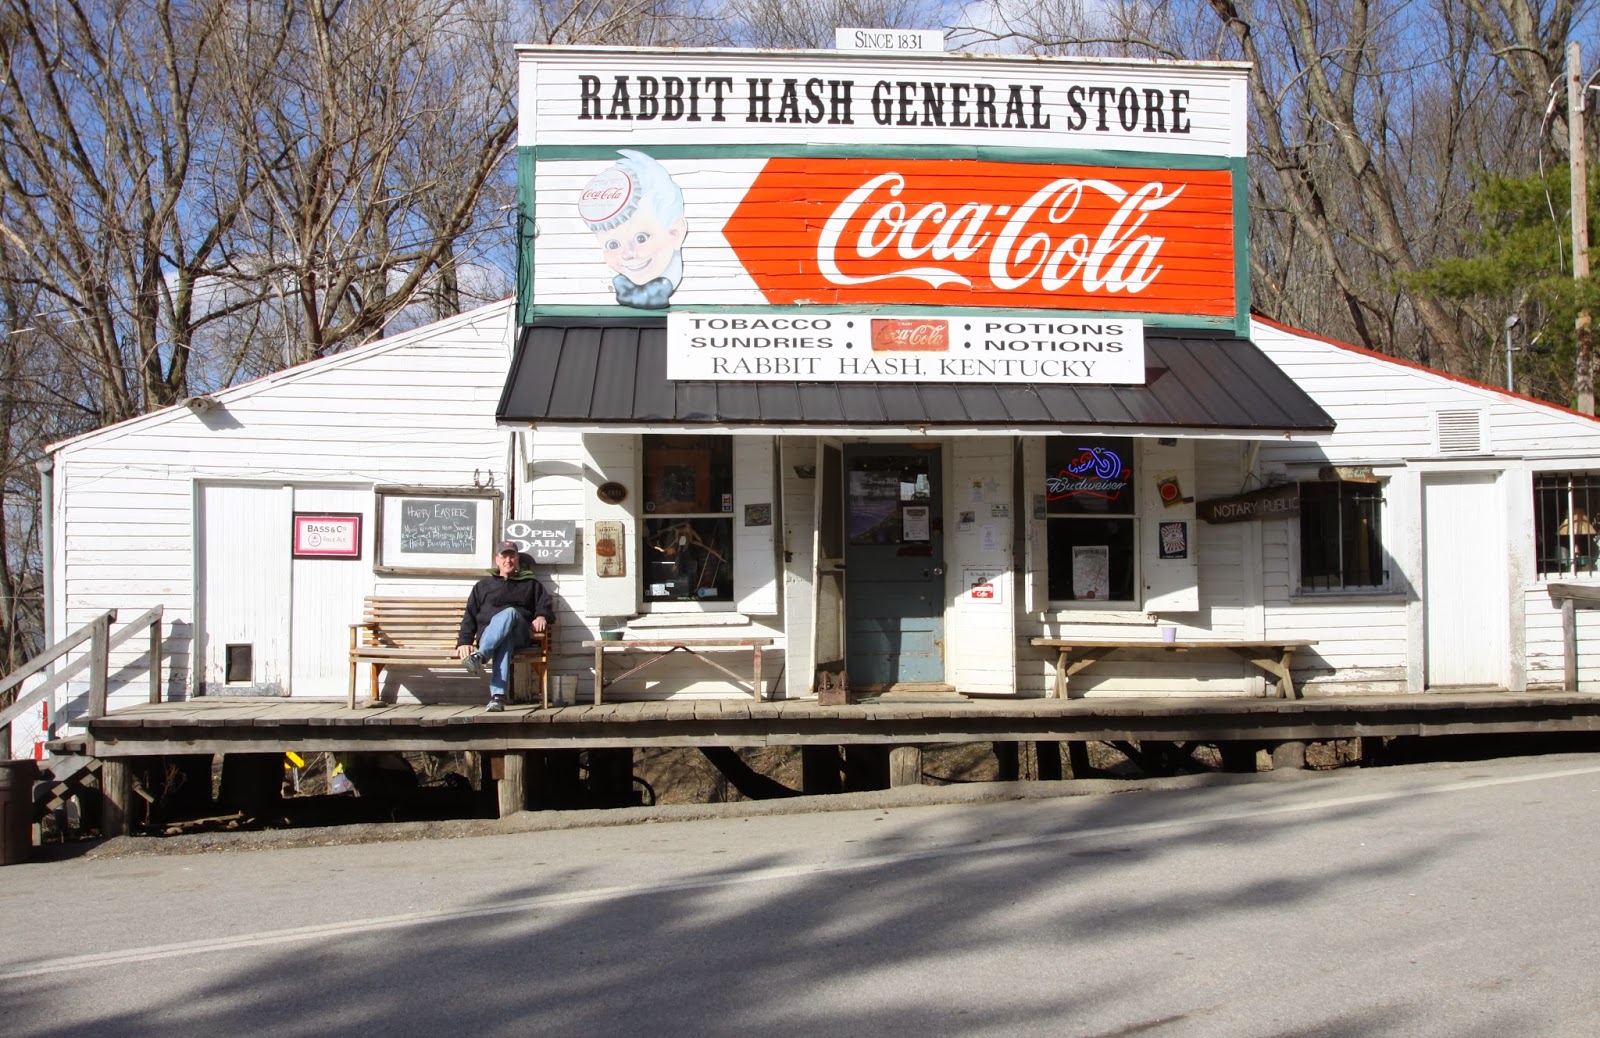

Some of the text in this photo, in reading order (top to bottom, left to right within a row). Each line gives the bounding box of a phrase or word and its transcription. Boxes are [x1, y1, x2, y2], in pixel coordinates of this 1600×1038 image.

[855, 30, 922, 49] SINCE 1831
[577, 74, 1191, 134] RABBIT HASH GENERAL STORE
[816, 171, 1187, 294] Coca-Cola
[689, 318, 832, 330] TOBACCO
[985, 322, 1124, 336] POTIONS
[690, 337, 833, 349] SUNDRIES
[985, 340, 1124, 353] NOTIONS
[711, 356, 1097, 378] RABBIT HASH, KENTUCKY
[1045, 476, 1127, 494] Budweiser
[1213, 497, 1299, 518] NOTARY PUBLIC
[506, 523, 566, 539] OPEN
